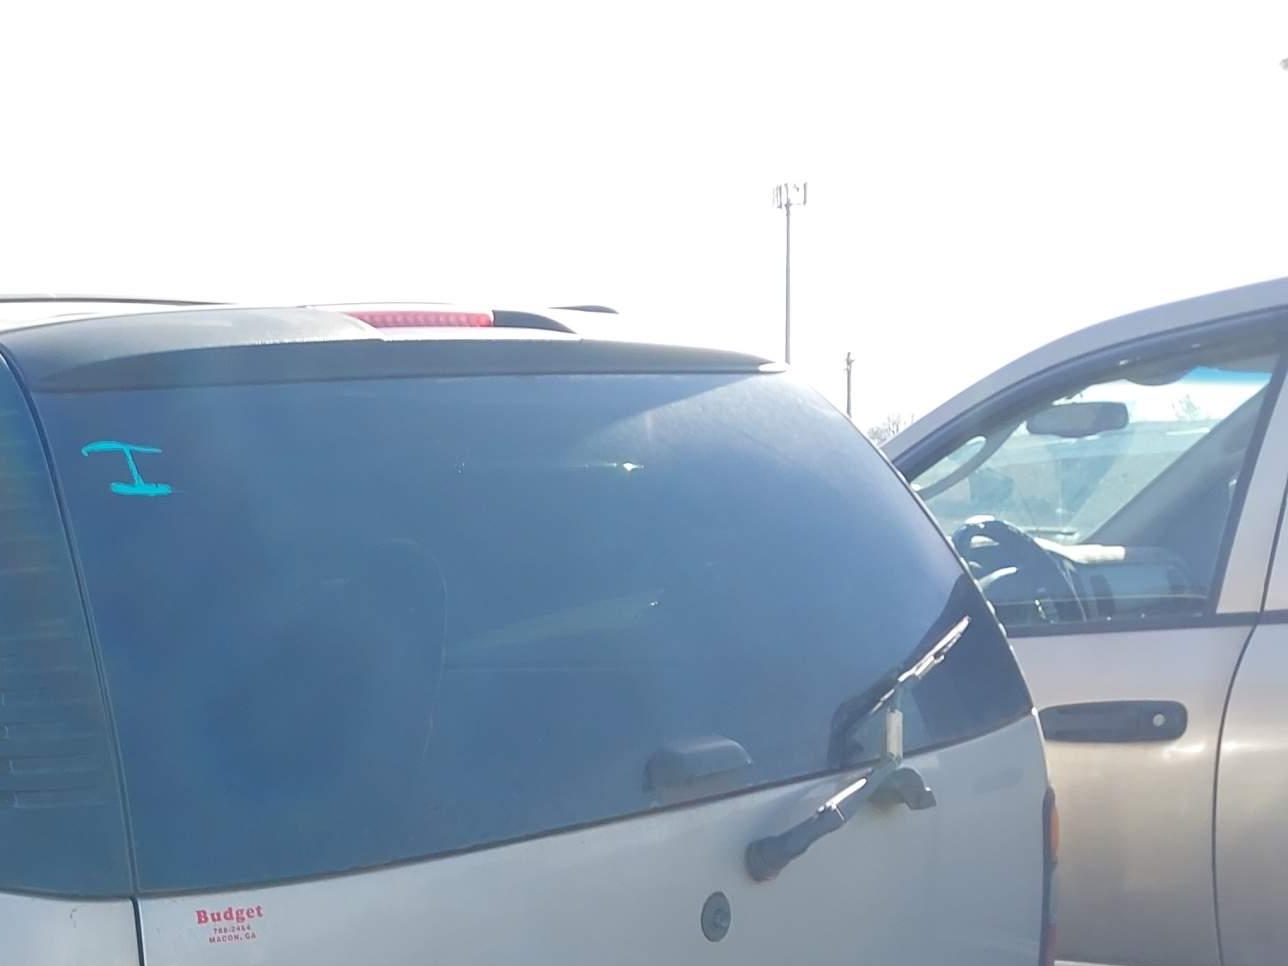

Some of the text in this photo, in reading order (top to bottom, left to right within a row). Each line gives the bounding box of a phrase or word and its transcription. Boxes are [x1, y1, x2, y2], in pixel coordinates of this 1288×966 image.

[196, 905, 263, 924] Budget
[208, 931, 256, 943] MACON, GA
